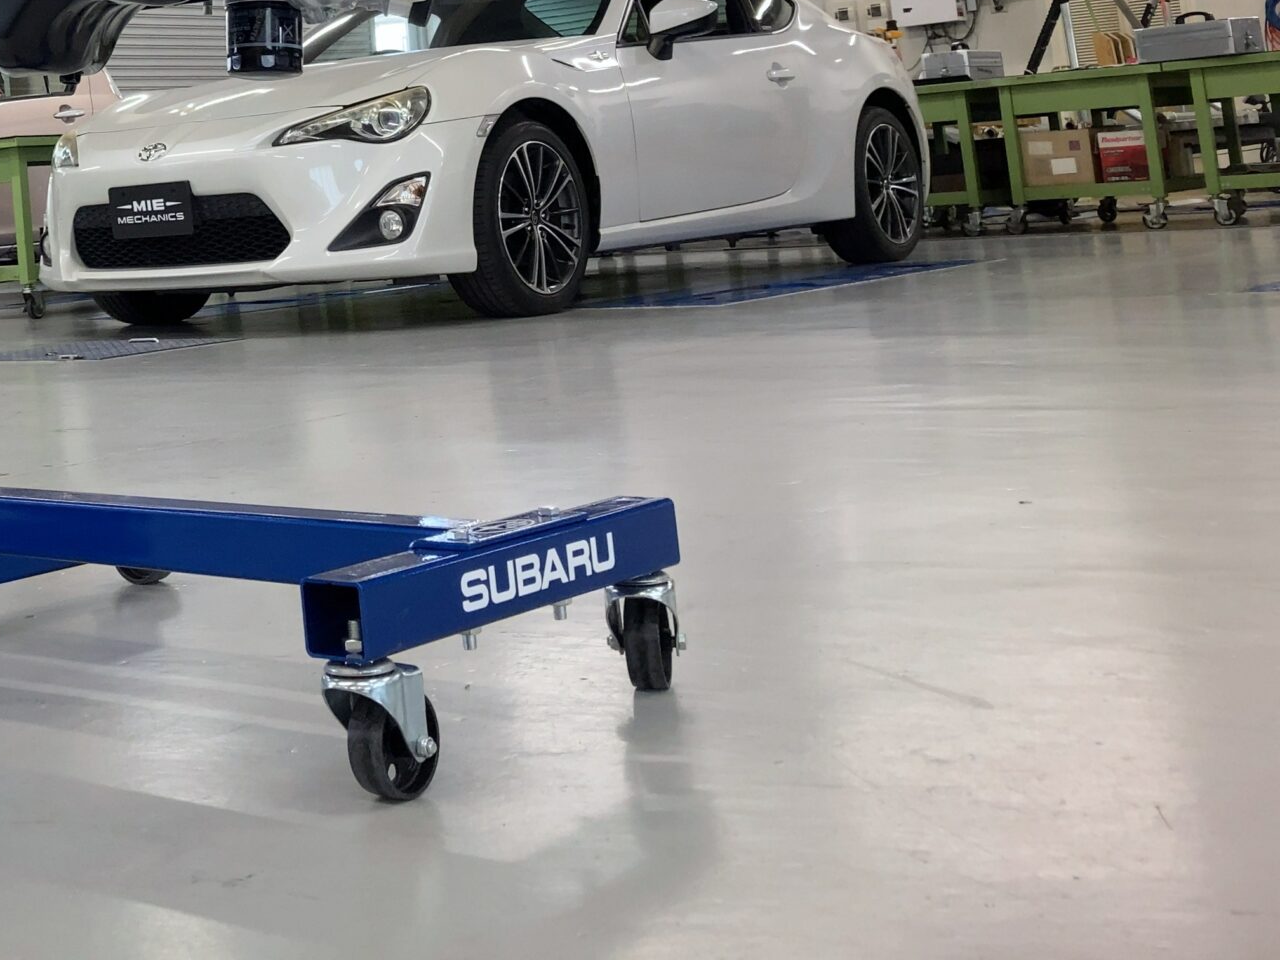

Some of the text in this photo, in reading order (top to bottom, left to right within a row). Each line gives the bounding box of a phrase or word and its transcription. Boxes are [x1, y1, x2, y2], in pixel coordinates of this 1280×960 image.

[132, 198, 165, 212] MIE
[117, 212, 184, 225] MECHANICS
[460, 532, 615, 613] SUBARU
